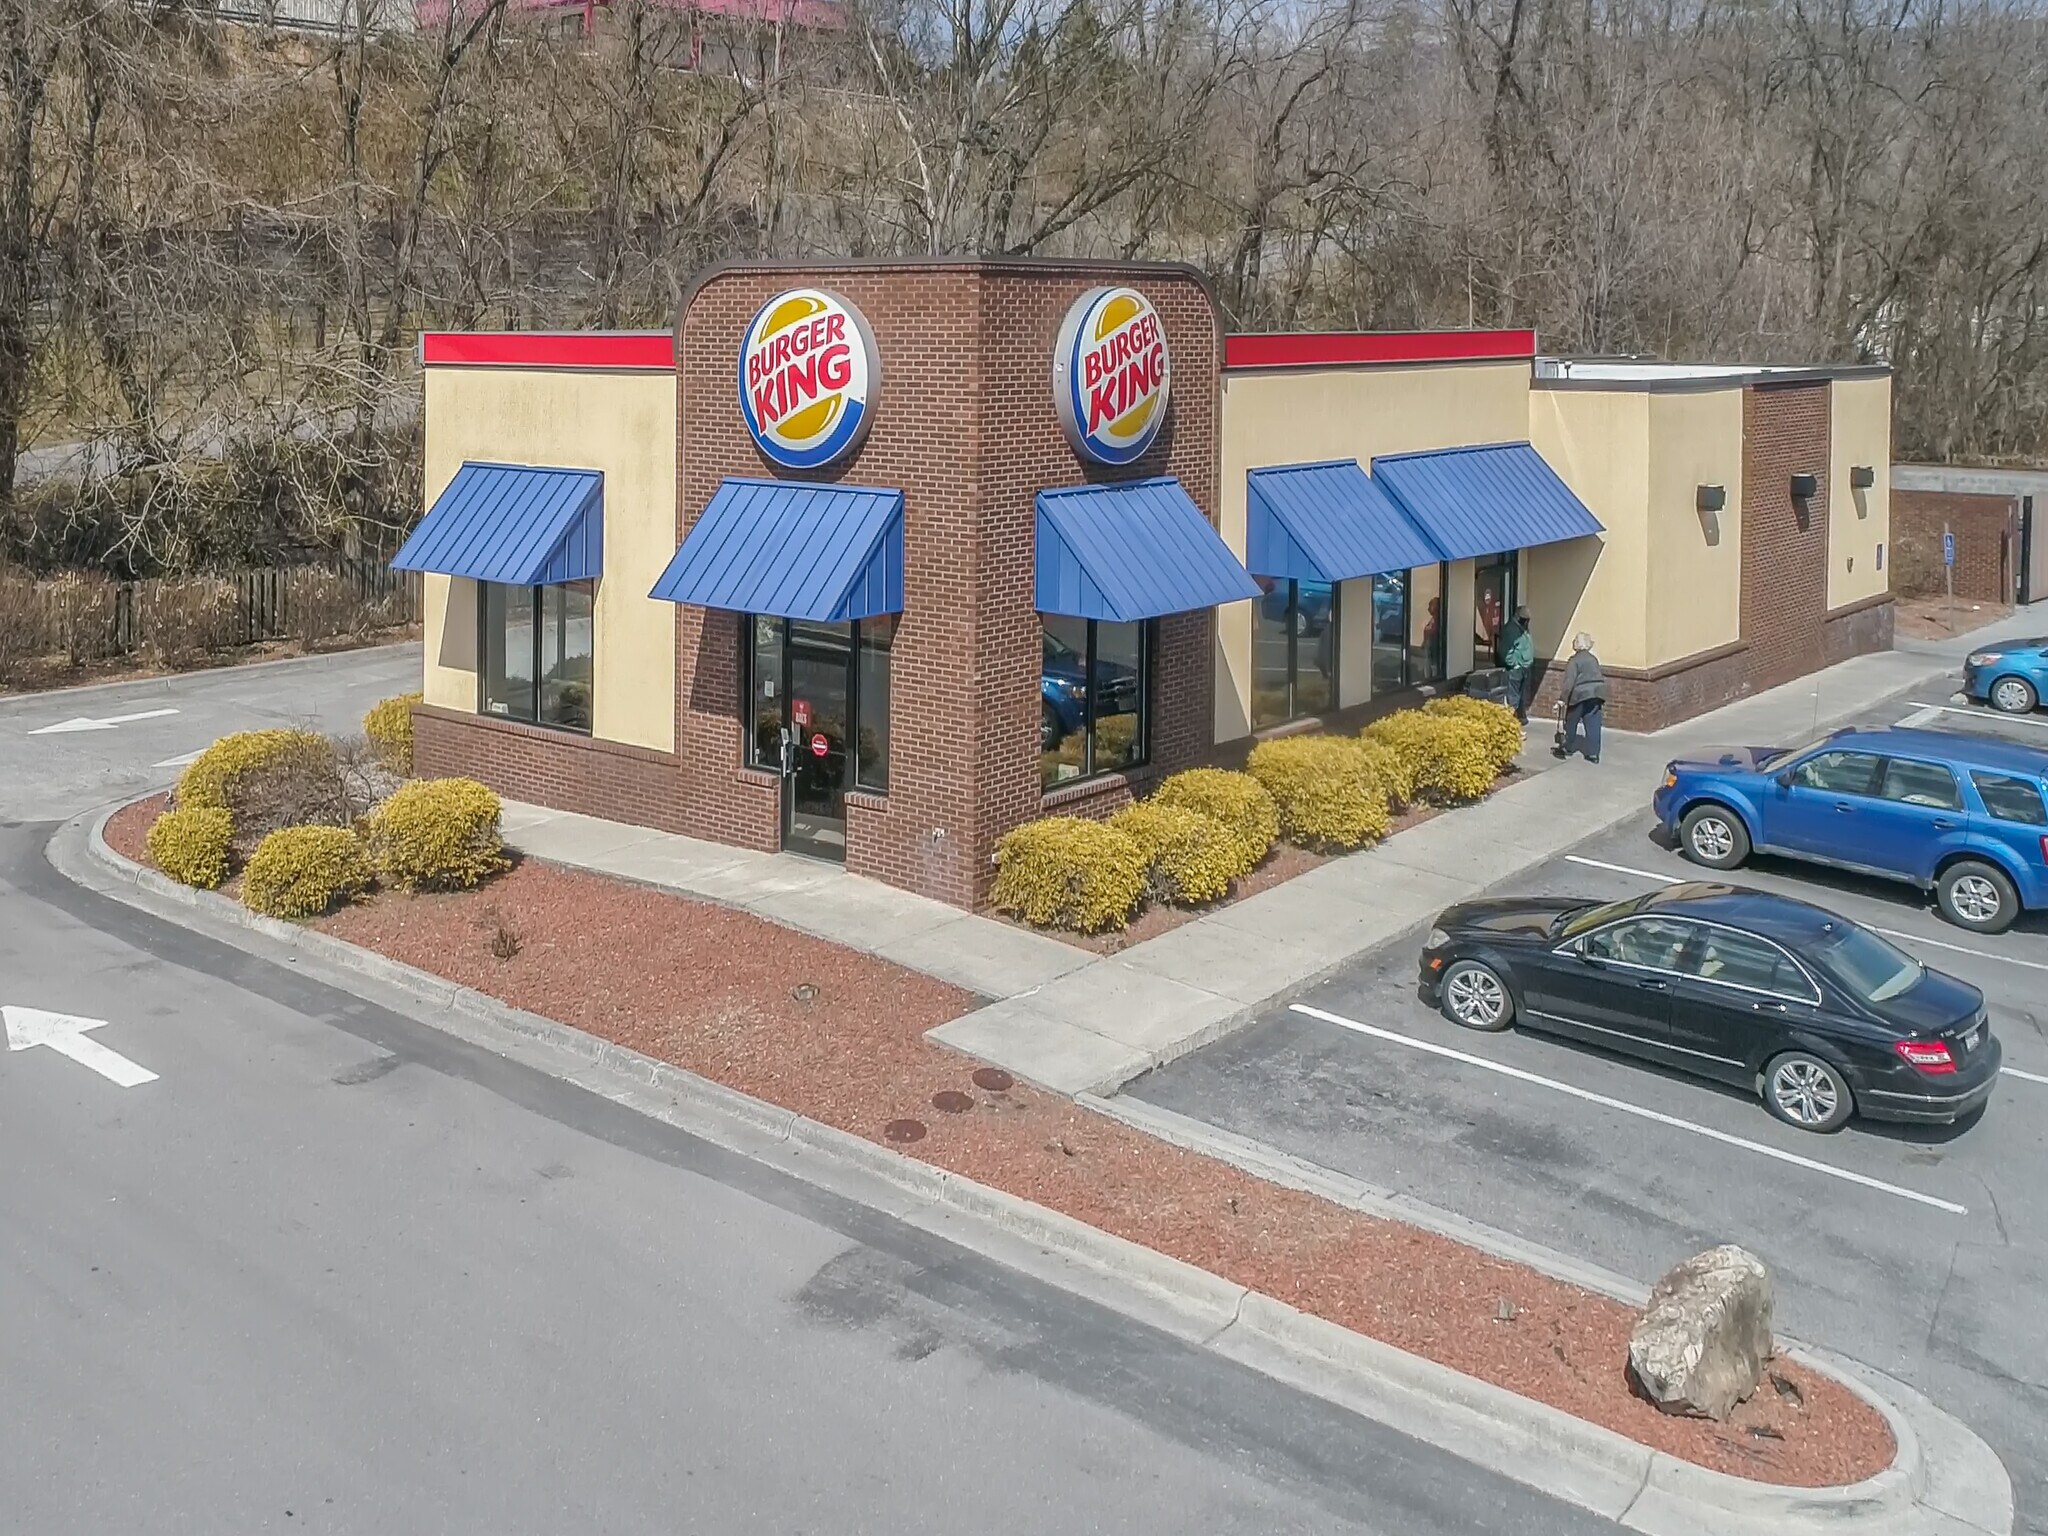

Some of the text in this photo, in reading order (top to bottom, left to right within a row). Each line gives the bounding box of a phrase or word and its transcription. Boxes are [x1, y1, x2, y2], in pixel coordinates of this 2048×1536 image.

[749, 313, 845, 390] BURGER
[754, 344, 852, 434] KING
[1085, 312, 1160, 389] BURGER
[1088, 342, 1164, 435] KING
